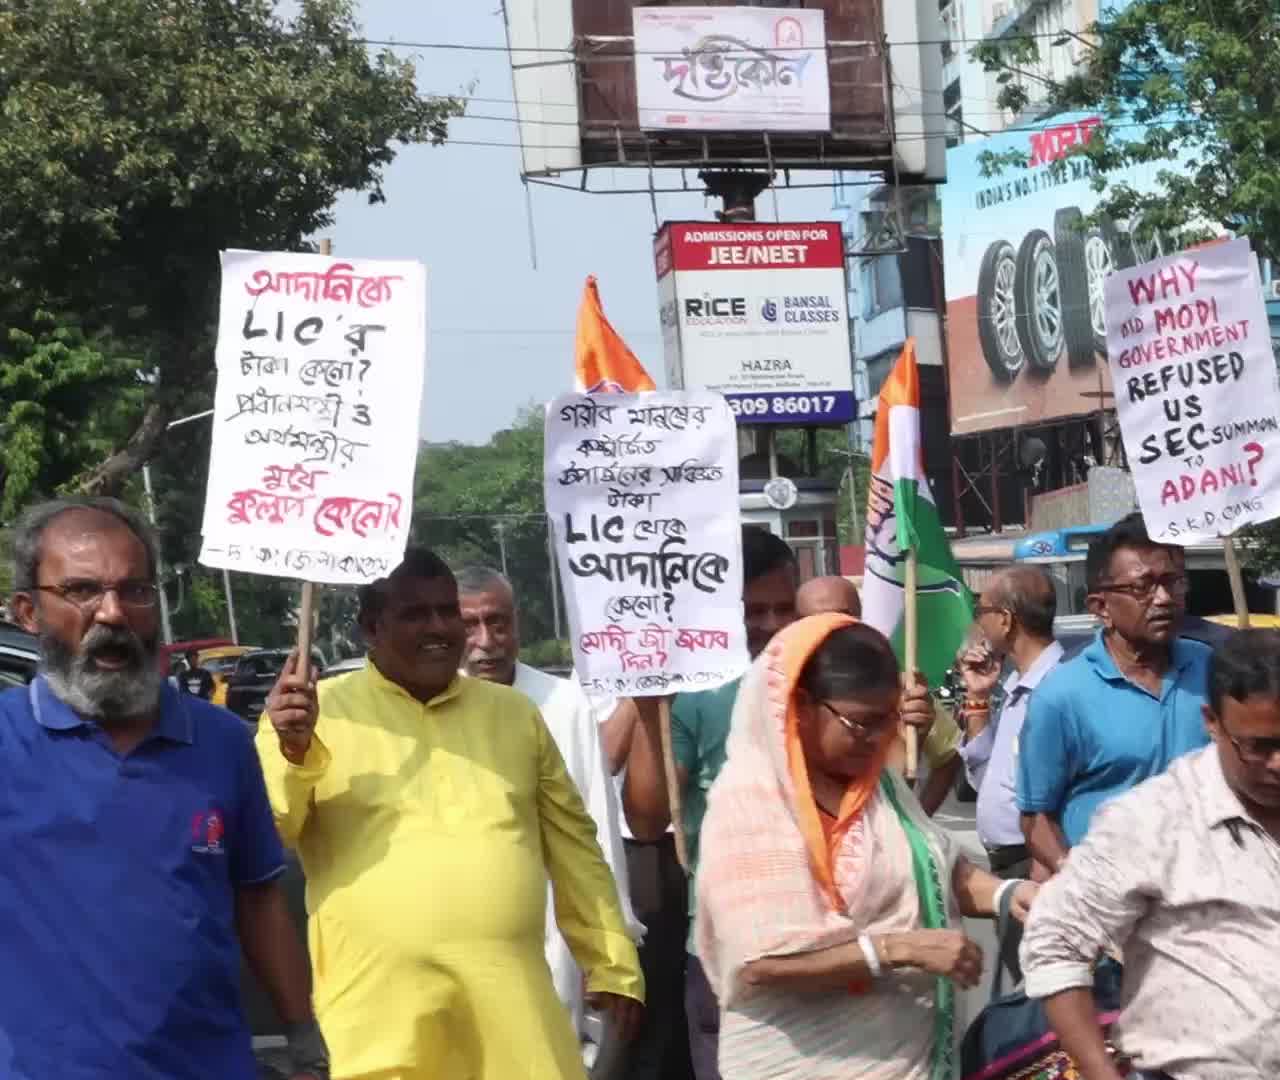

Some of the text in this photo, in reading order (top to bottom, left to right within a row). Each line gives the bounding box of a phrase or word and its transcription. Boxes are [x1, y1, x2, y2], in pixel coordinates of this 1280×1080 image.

[976, 180, 1013, 210] INDIA'S
[1040, 162, 1068, 190] TYRE
[684, 229, 828, 242] ADMISSIONS OPEN FOR
[708, 245, 808, 265] JEE/NEET
[1128, 260, 1199, 306] WHY
[784, 296, 833, 308] BANSAL
[784, 311, 839, 323] CLASSES
[1121, 296, 1218, 338] DID MODI
[1119, 320, 1249, 368] GOVERNMENT
[741, 359, 792, 371] HAZRA
[1128, 351, 1245, 402] REFUSED
[772, 396, 836, 414] 86017
[1164, 394, 1202, 421] US
[1139, 416, 1278, 464] SEC SUMMON
[1161, 442, 1265, 507] ADANI?
[1184, 455, 1204, 468] TO
[566, 512, 624, 543] LIC
[568, 537, 729, 593] আদানিকে
